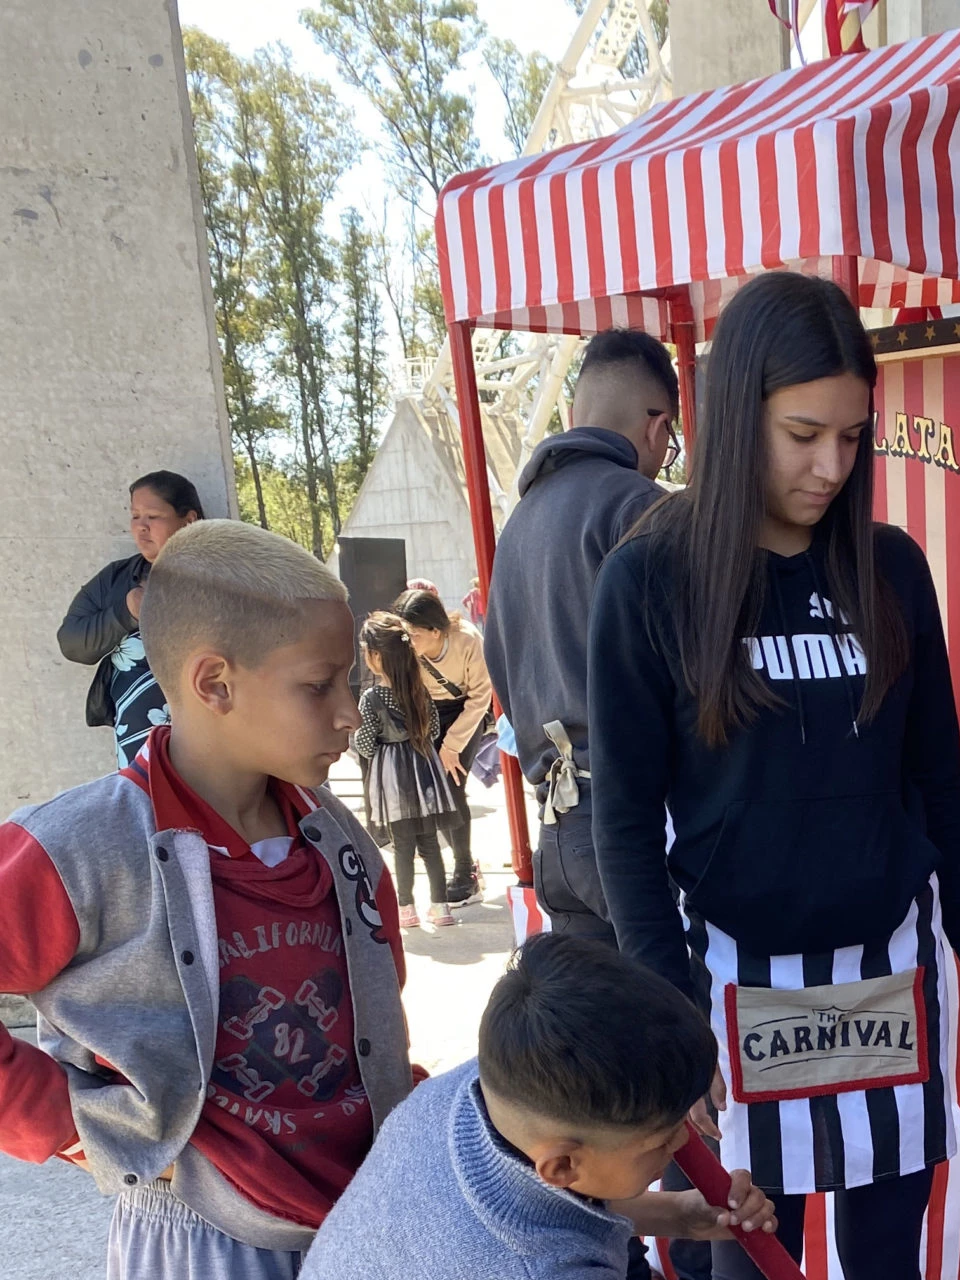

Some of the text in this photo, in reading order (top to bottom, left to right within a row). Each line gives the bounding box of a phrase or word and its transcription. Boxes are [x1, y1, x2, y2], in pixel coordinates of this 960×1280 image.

[741, 633, 867, 680] PUMA
[218, 920, 343, 968] ALIFORNIA
[273, 1022, 312, 1065] 82
[743, 1020, 914, 1062] CARNIVAL
